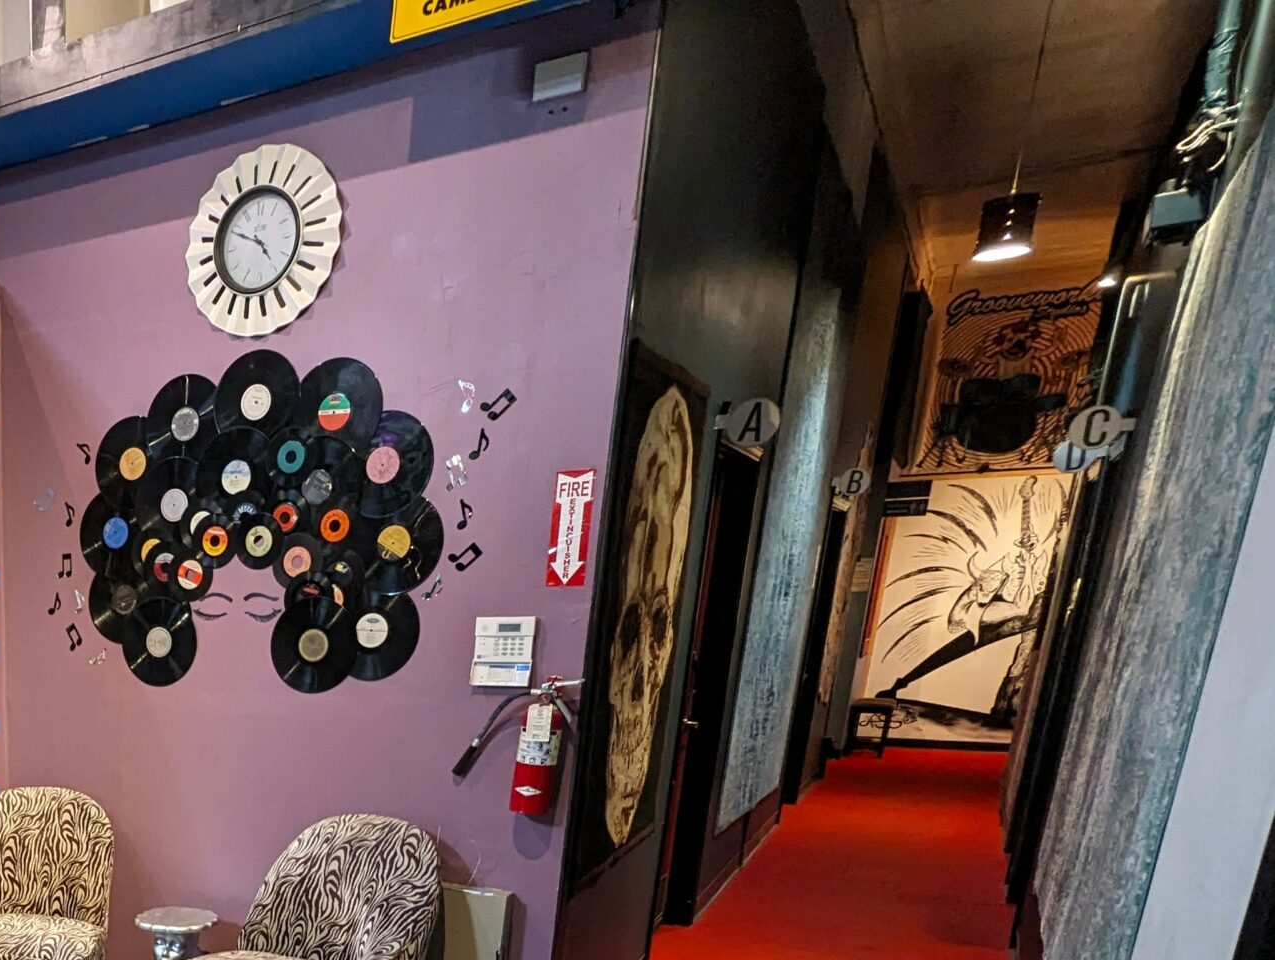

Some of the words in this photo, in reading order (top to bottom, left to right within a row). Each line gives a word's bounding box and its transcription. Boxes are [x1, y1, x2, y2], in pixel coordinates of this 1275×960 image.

[422, 0, 476, 16] CAM
[737, 401, 762, 442] A
[1083, 408, 1110, 447] C
[559, 480, 590, 498] FIRE
[846, 469, 863, 494] B
[562, 498, 576, 579] EXTINGUISHER
